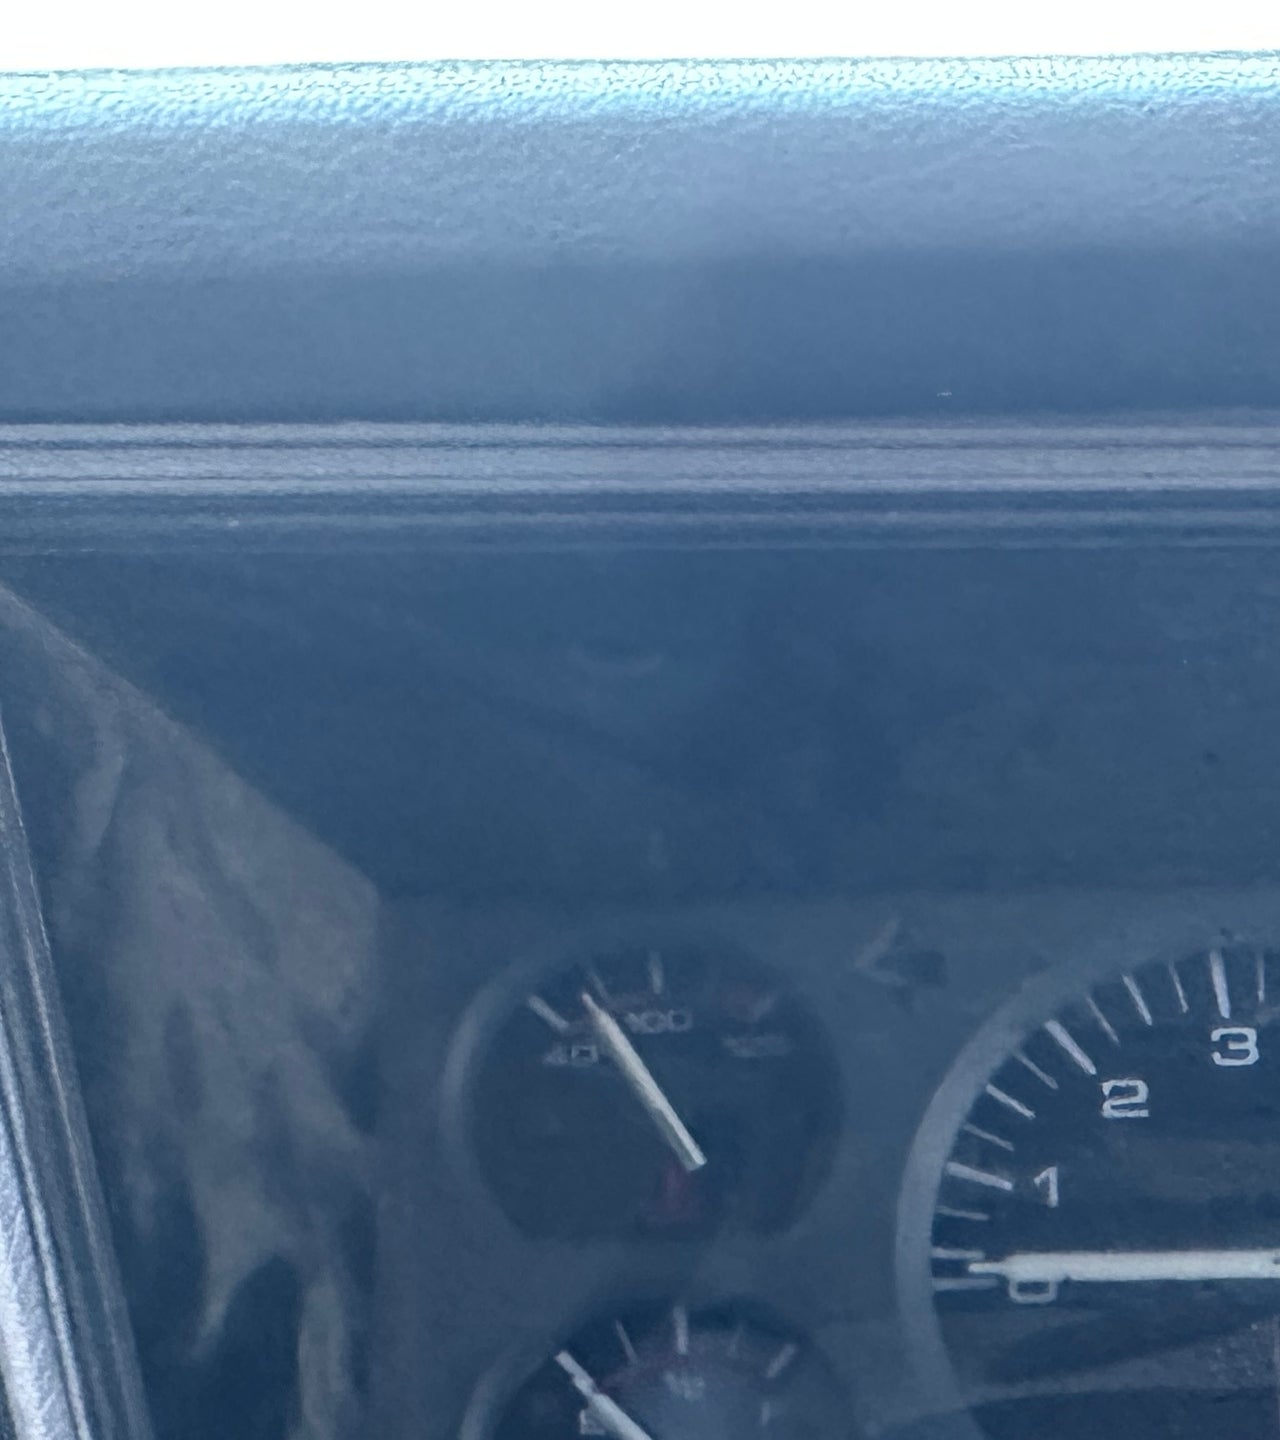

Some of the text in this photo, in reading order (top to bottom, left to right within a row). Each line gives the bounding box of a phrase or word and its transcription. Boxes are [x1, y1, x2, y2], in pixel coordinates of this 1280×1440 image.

[1210, 1027, 1260, 1067] 3
[1100, 1078, 1150, 1119] 2
[1033, 1166, 1059, 1207] 1
